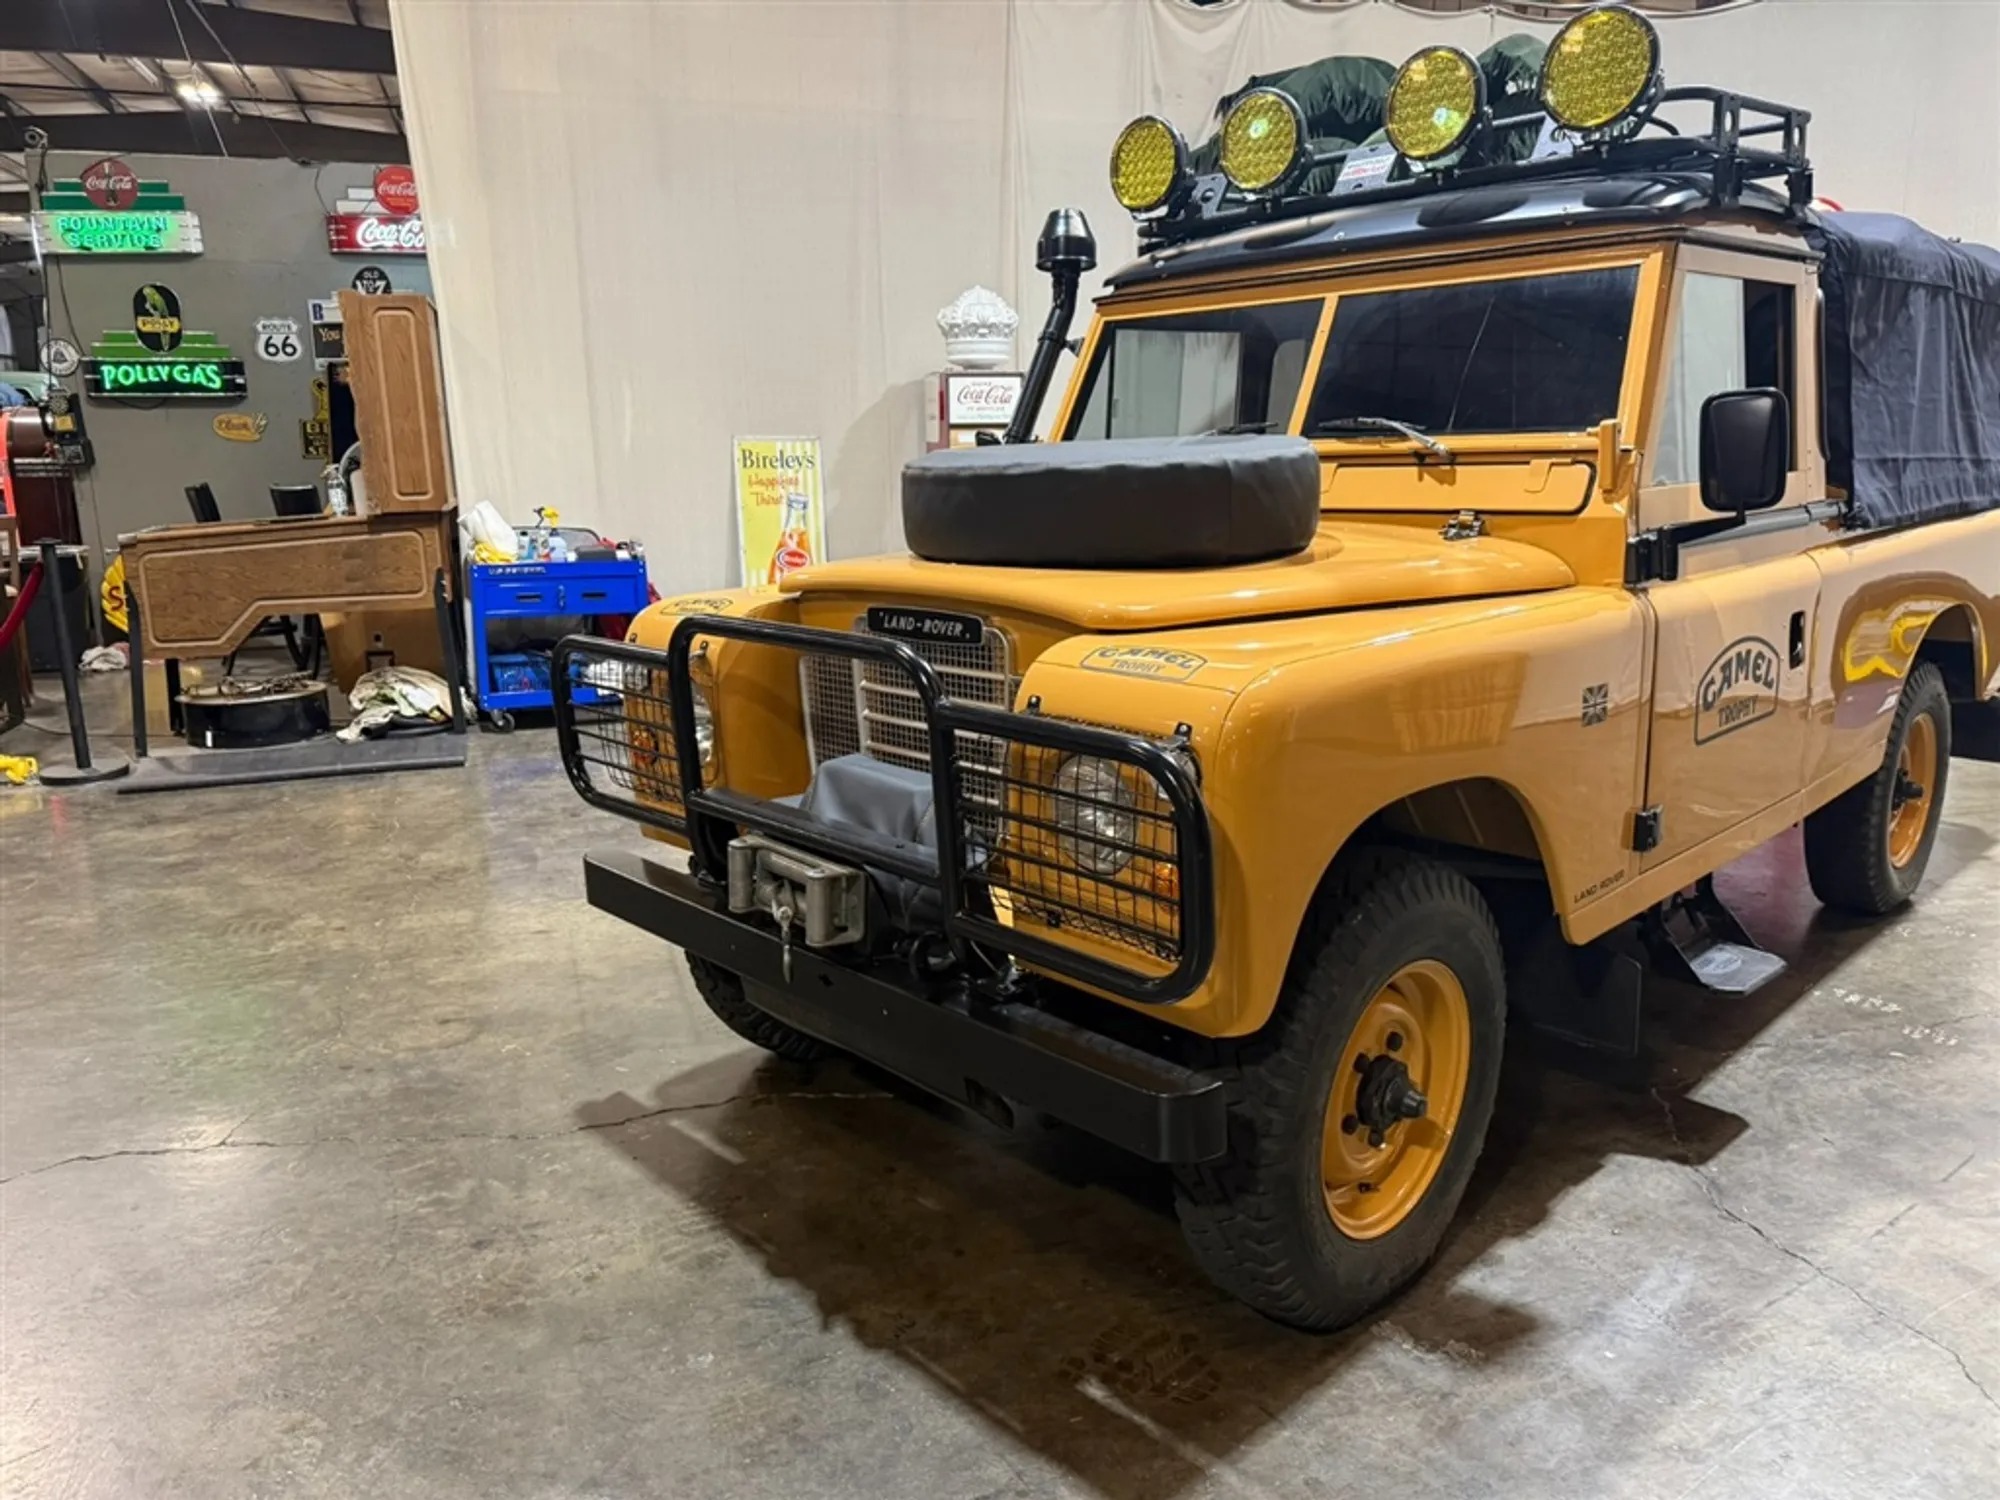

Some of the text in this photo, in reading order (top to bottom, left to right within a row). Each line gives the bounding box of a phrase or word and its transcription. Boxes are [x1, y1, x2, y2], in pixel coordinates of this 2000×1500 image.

[58, 216, 168, 232] FOUNTAIN
[356, 218, 425, 247] Coca-Co
[69, 233, 162, 249] SERVICE
[264, 335, 298, 357] 66
[100, 363, 221, 390] POLLY GAS
[742, 448, 816, 475] Bireley's
[1098, 648, 1197, 669] CAMEL
[1111, 659, 1166, 674] TROPHY
[1702, 648, 1774, 712] CAMEL
[1718, 694, 1760, 728] TROPHY
[1573, 884, 1598, 905] LAND
